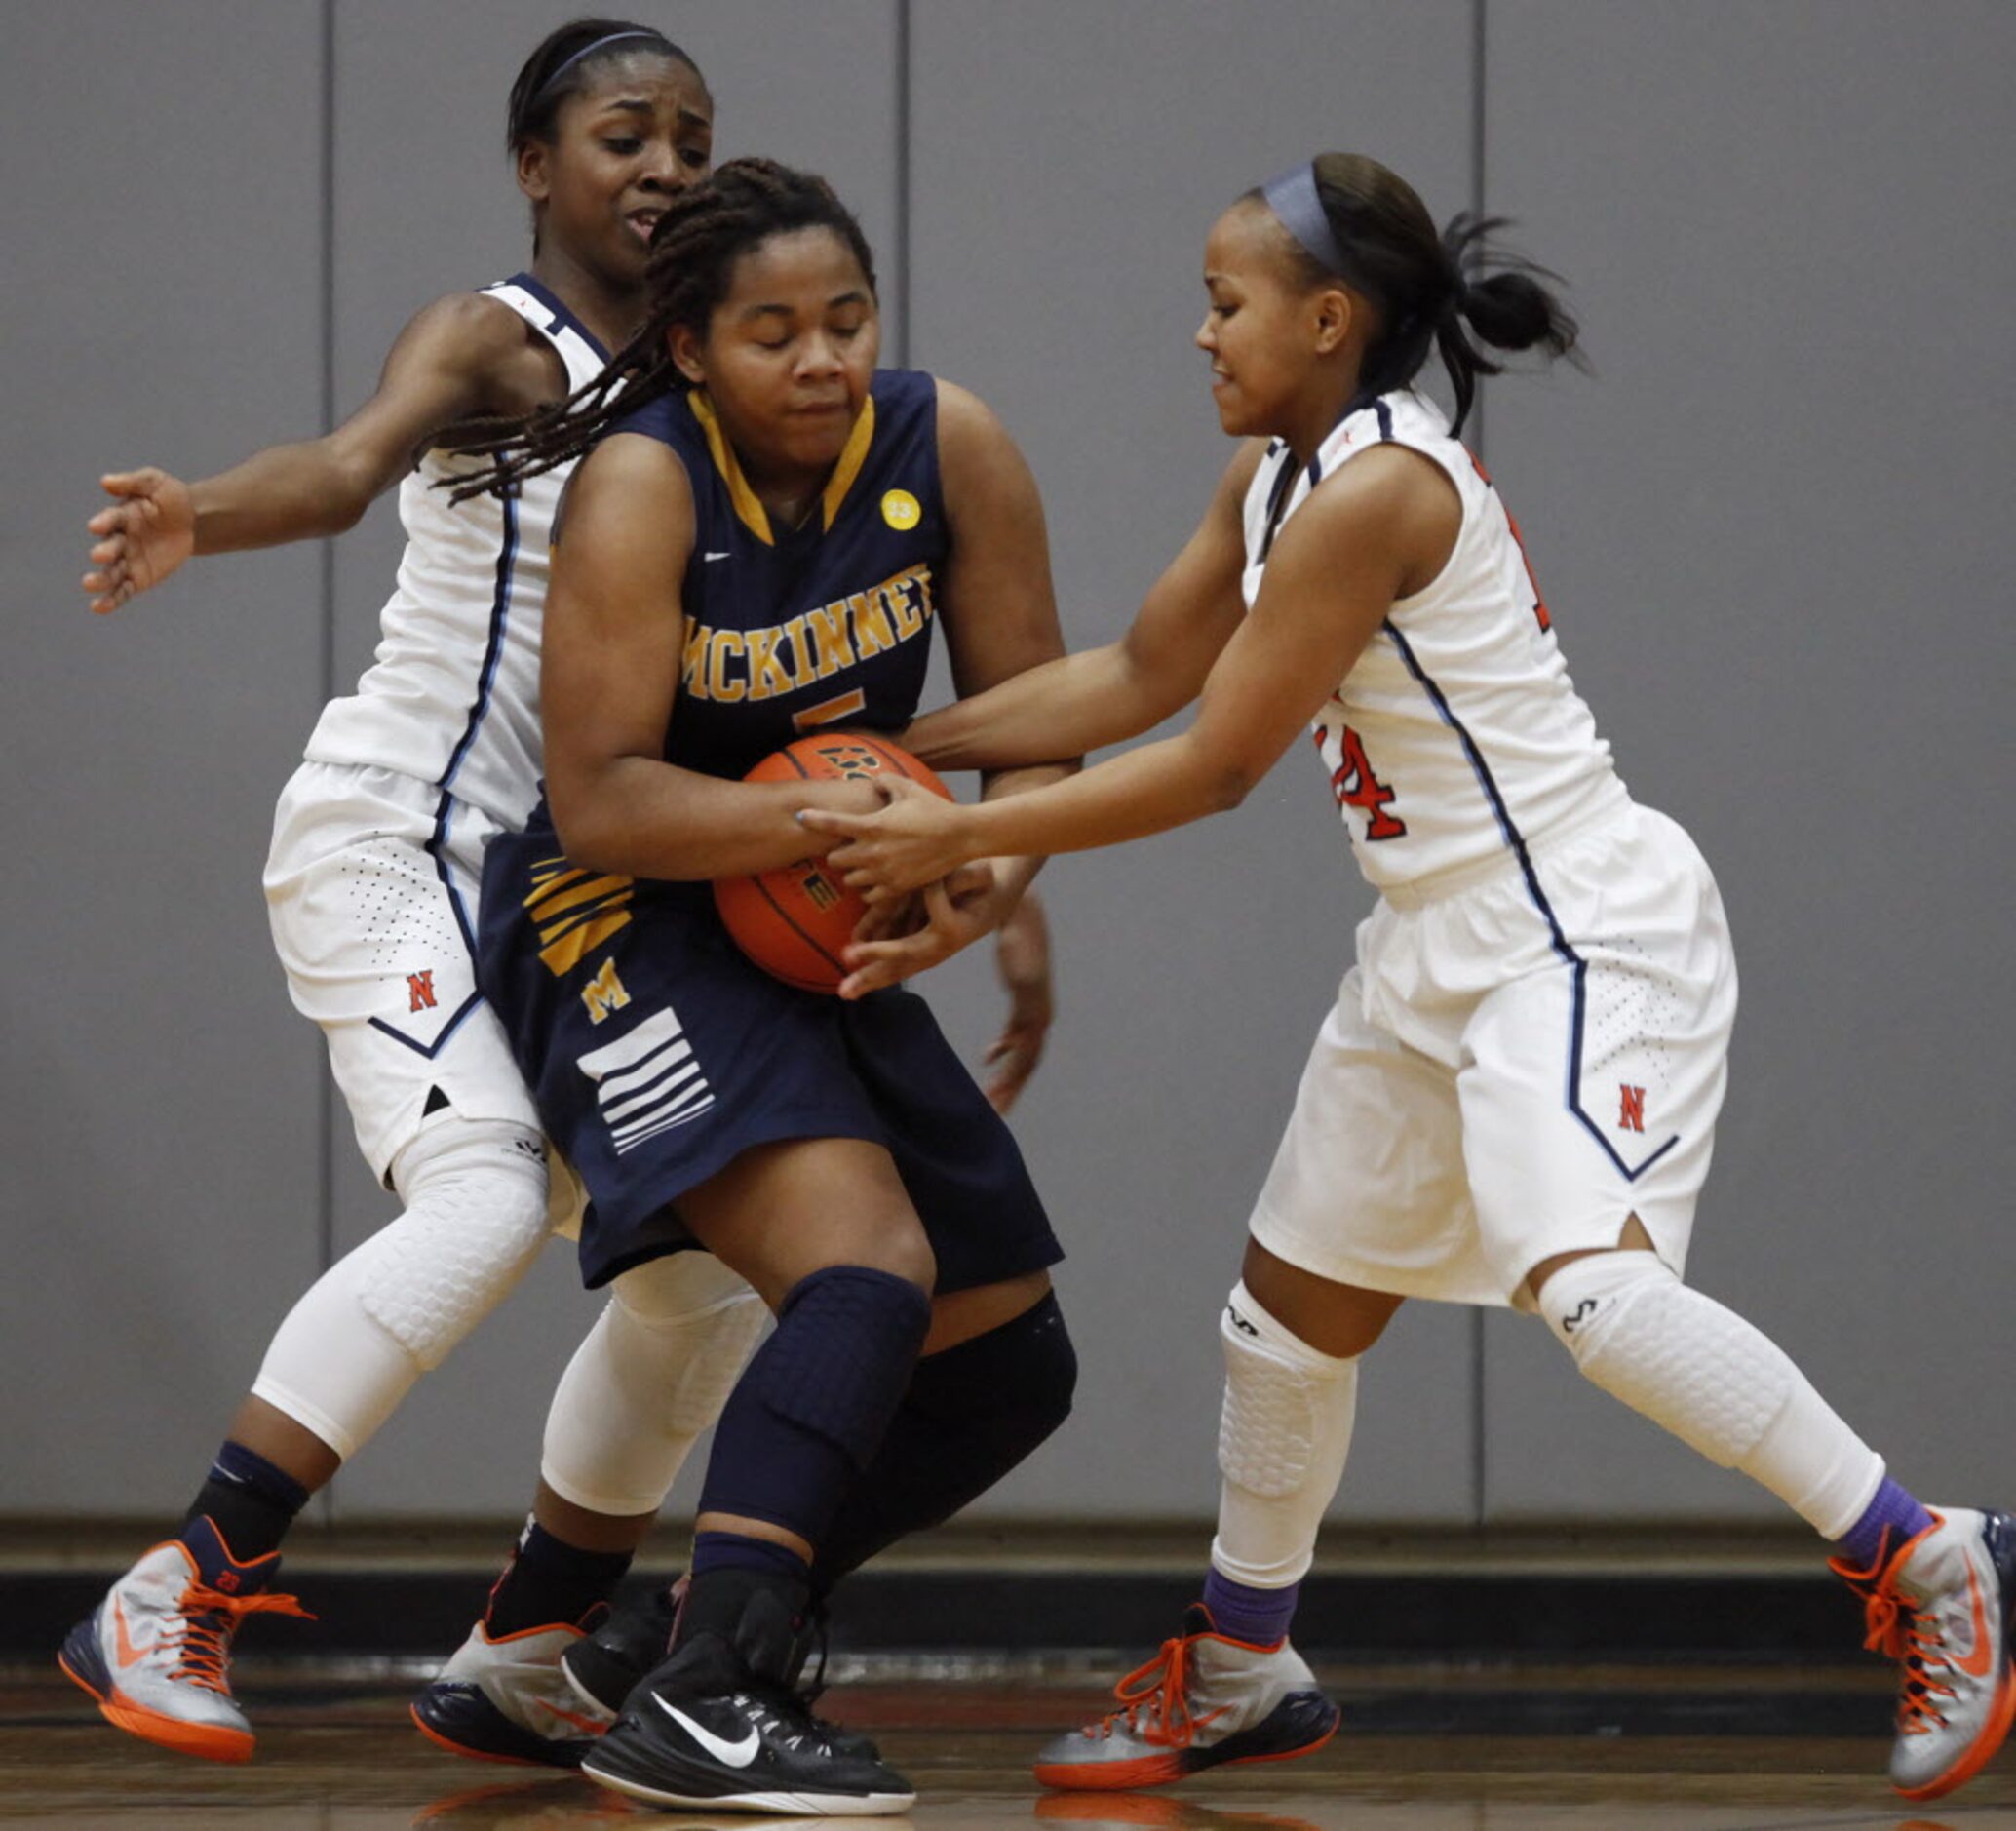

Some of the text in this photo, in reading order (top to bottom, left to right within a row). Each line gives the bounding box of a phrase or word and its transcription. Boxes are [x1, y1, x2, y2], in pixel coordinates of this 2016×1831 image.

[407, 970, 438, 1013] N
[581, 956, 632, 1025] M
[1618, 1083, 1647, 1133] N
